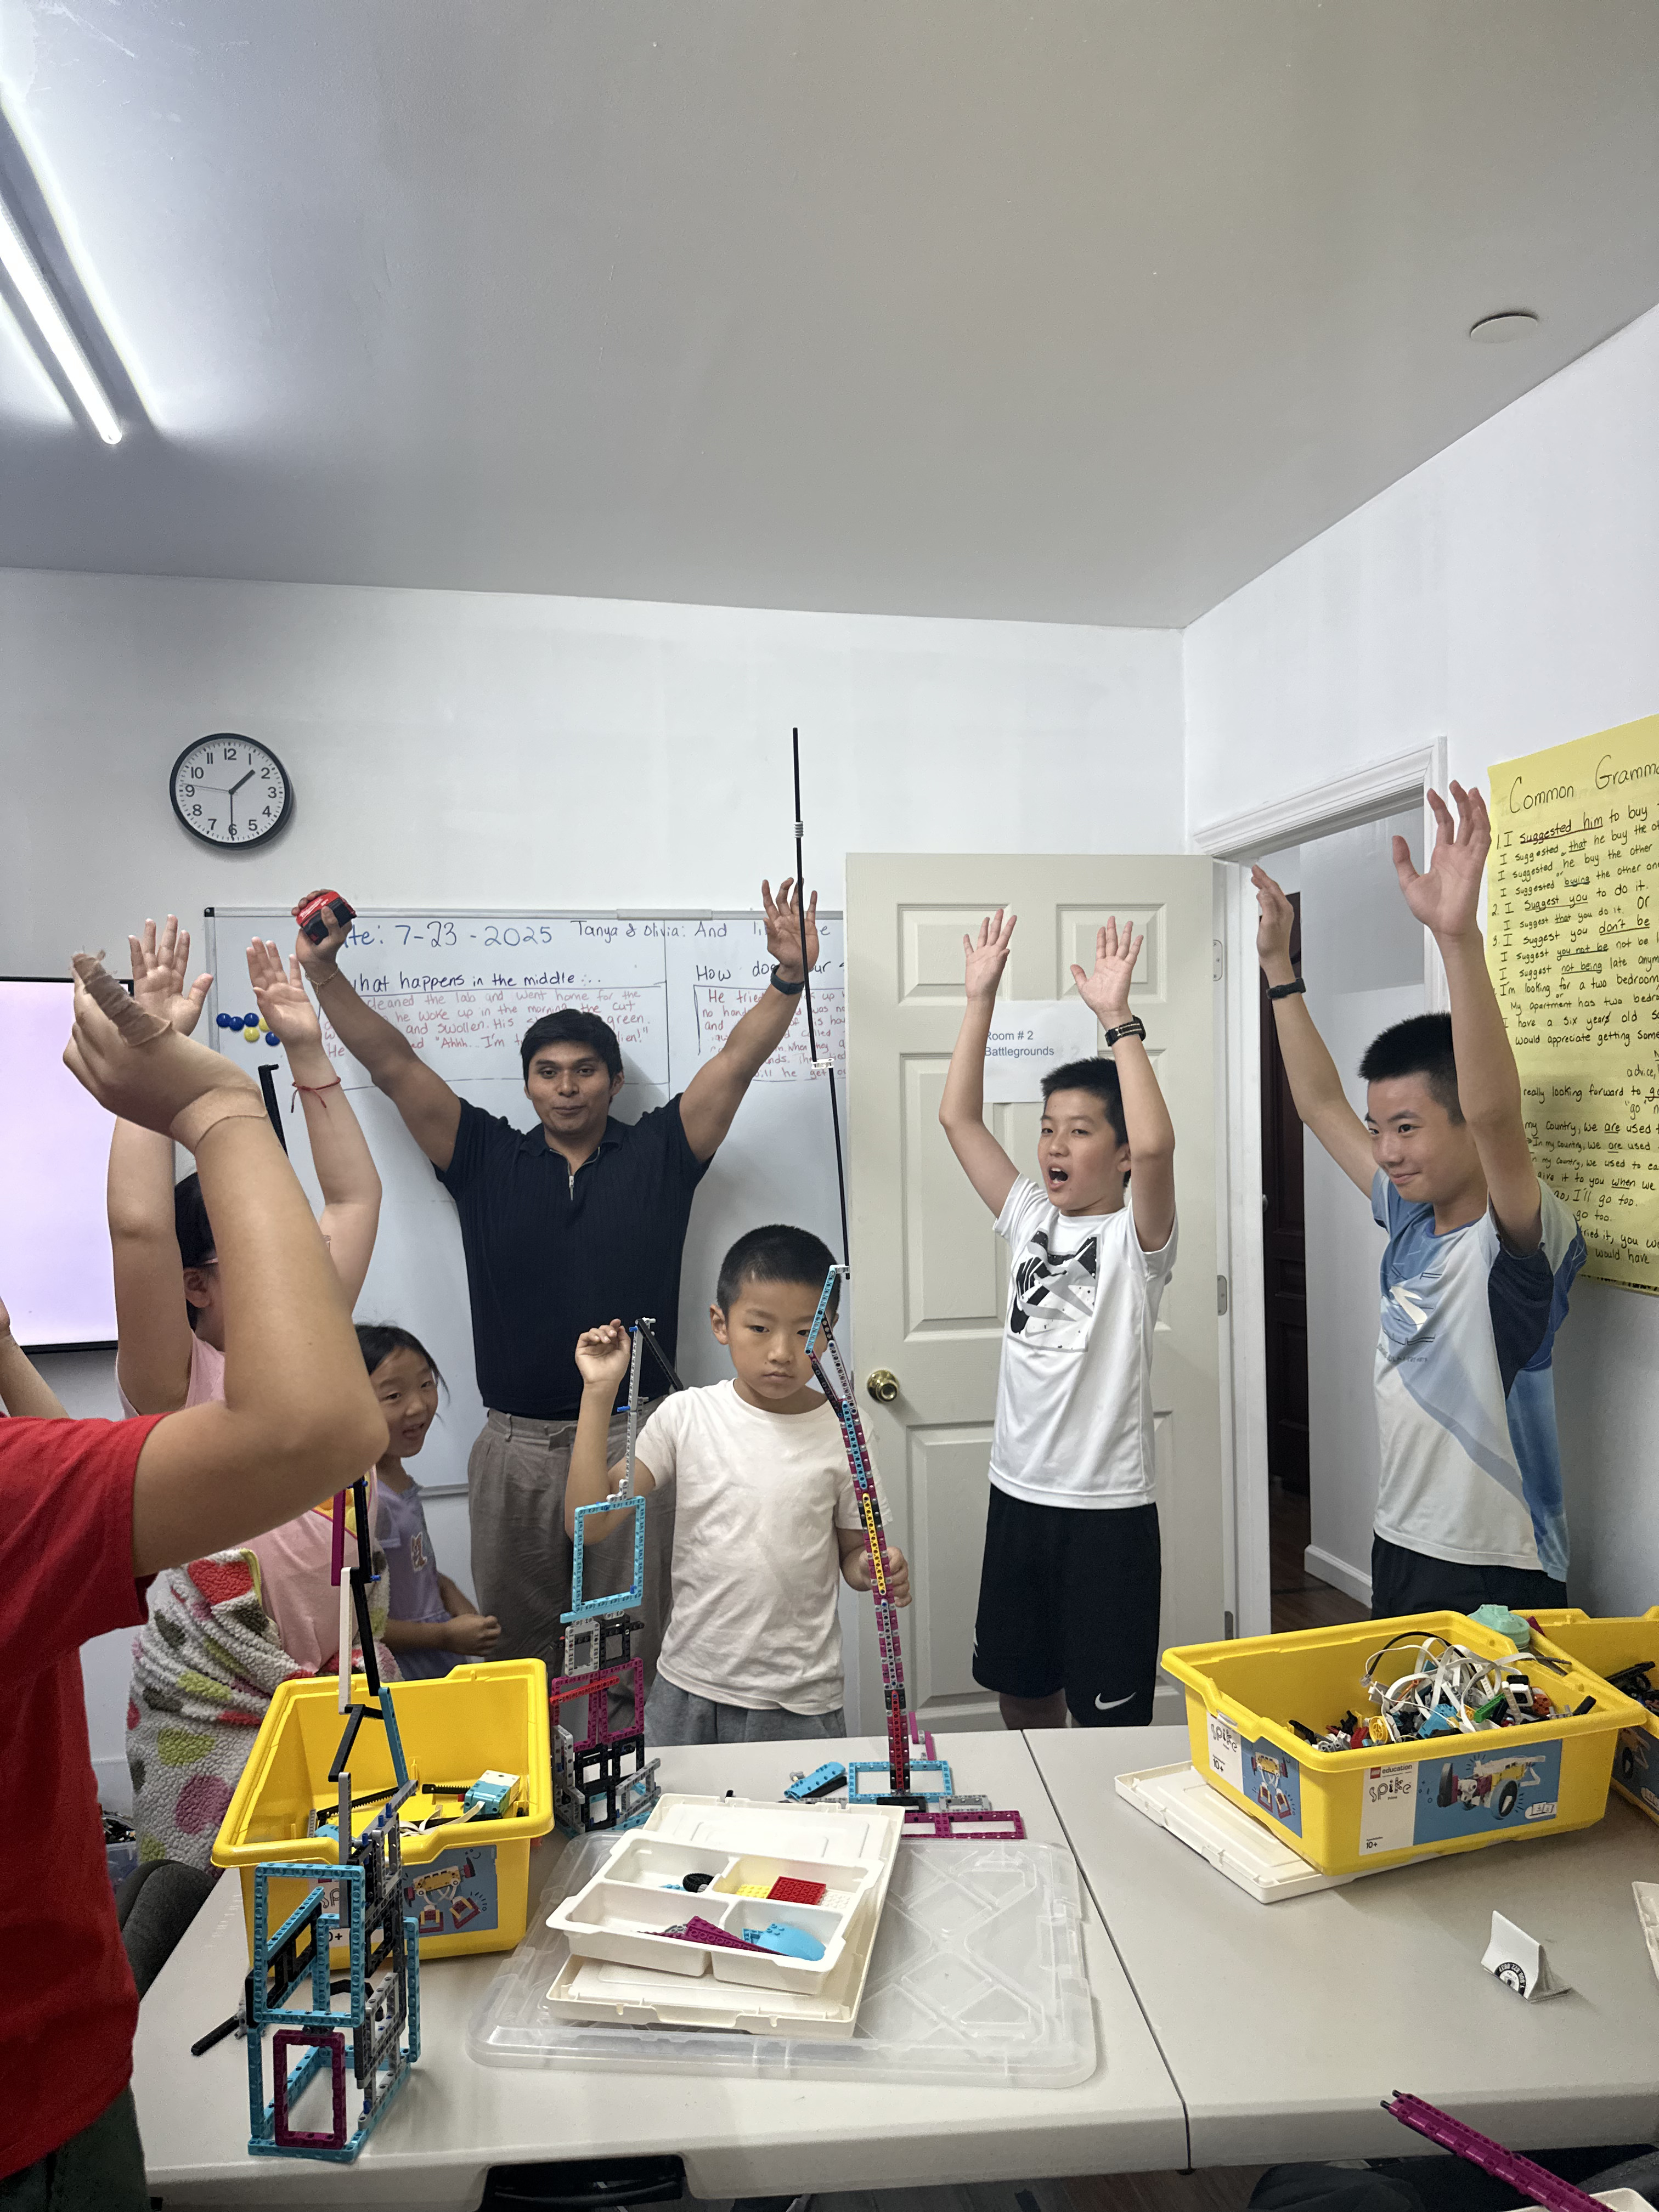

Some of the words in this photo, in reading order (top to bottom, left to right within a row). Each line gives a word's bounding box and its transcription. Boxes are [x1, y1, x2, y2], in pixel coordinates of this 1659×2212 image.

[207, 752, 213, 764] 11
[224, 748, 237, 760] 12
[249, 753, 252, 765] 1
[190, 766, 204, 779] 10
[261, 767, 270, 779] 2
[185, 785, 195, 797] 9
[268, 787, 277, 799] 3
[1510, 776, 1573, 813] Common
[193, 804, 202, 816] 8
[262, 805, 272, 817] 4
[207, 819, 217, 831] 7
[228, 823, 238, 836] 6
[249, 819, 258, 831] 5
[1504, 831, 1513, 847] I
[1583, 812, 1602, 829] him
[1609, 808, 1619, 823] to
[1628, 804, 1648, 821] buy
[1500, 854, 1506, 866] I
[1569, 840, 1587, 850] that
[1594, 833, 1605, 844] he
[1611, 830, 1628, 845] buy
[1498, 870, 1505, 881] I
[1513, 862, 1553, 882] suggested
[1564, 859, 1575, 868] he
[1584, 854, 1599, 866] buy
[1608, 850, 1622, 859] the
[1630, 844, 1652, 855] other
[1500, 888, 1506, 897] I
[1515, 881, 1555, 896] suggested
[1596, 869, 1610, 880] the
[1617, 864, 1641, 876] other
[1505, 902, 1514, 913] I
[1569, 894, 1587, 909] you
[1596, 888, 1606, 897] to
[1615, 883, 1628, 896] do
[570, 920, 618, 943] Tanya
[695, 921, 727, 938] And
[1503, 934, 1513, 946] I
[1523, 931, 1560, 948] suggest
[1571, 928, 1587, 942] you
[1599, 919, 1625, 934] don't
[1637, 915, 1650, 926] be
[696, 964, 731, 981] How
[354, 973, 389, 992] hat
[400, 971, 465, 991] happens
[473, 976, 483, 986] in
[492, 973, 517, 986] the
[1500, 981, 1515, 996] I'm
[1525, 982, 1550, 997] looking
[1559, 977, 1570, 990] for
[1591, 977, 1607, 989] two
[425, 994, 445, 1005] the
[456, 991, 476, 1003] lab
[486, 991, 504, 1002] and
[555, 989, 589, 1001] home
[597, 989, 613, 1001] for
[622, 990, 641, 1002] the
[709, 989, 725, 1003] He
[822, 992, 835, 1001] up
[396, 1012, 411, 1023] he
[458, 1009, 473, 1019] up
[479, 1007, 490, 1017] in
[498, 1004, 517, 1014] the
[580, 1002, 602, 1013] the
[612, 1001, 635, 1011] cut
[1511, 1002, 1521, 1015] My
[1578, 997, 1595, 1007] has
[703, 1009, 713, 1018] no
[1518, 1015, 1536, 1028] have
[1564, 1017, 1577, 1025] six
[1622, 1010, 1637, 1023] old
[405, 1022, 428, 1034] and
[493, 1018, 514, 1030] His
[704, 1020, 724, 1031] and
[988, 1031, 1014, 1040] Room
[1018, 1030, 1024, 1040] #
[1027, 1030, 1034, 1040] 2
[1515, 1035, 1540, 1045] would
[1548, 1034, 1590, 1047] appreciate
[1598, 1031, 1630, 1047] getting
[328, 1043, 345, 1058] He
[985, 1046, 1054, 1058] Battlegrounds
[782, 1068, 797, 1078] he
[810, 1068, 826, 1080] get
[1523, 1087, 1545, 1104] really
[1553, 1086, 1582, 1102] looking
[1589, 1084, 1623, 1096] forward
[1631, 1085, 1641, 1095] to
[1525, 1121, 1538, 1136] my
[1604, 1123, 1620, 1132] are
[1627, 1123, 1651, 1133] used
[1562, 1172, 1568, 1182] it
[1575, 1173, 1584, 1182] to
[1589, 1177, 1604, 1187] you
[1611, 1178, 1635, 1188] when
[1599, 1194, 1611, 1207] go
[1576, 1210, 1588, 1221] go
[1382, 1764, 1412, 1774] education
[1366, 1841, 1378, 1849] 10+
